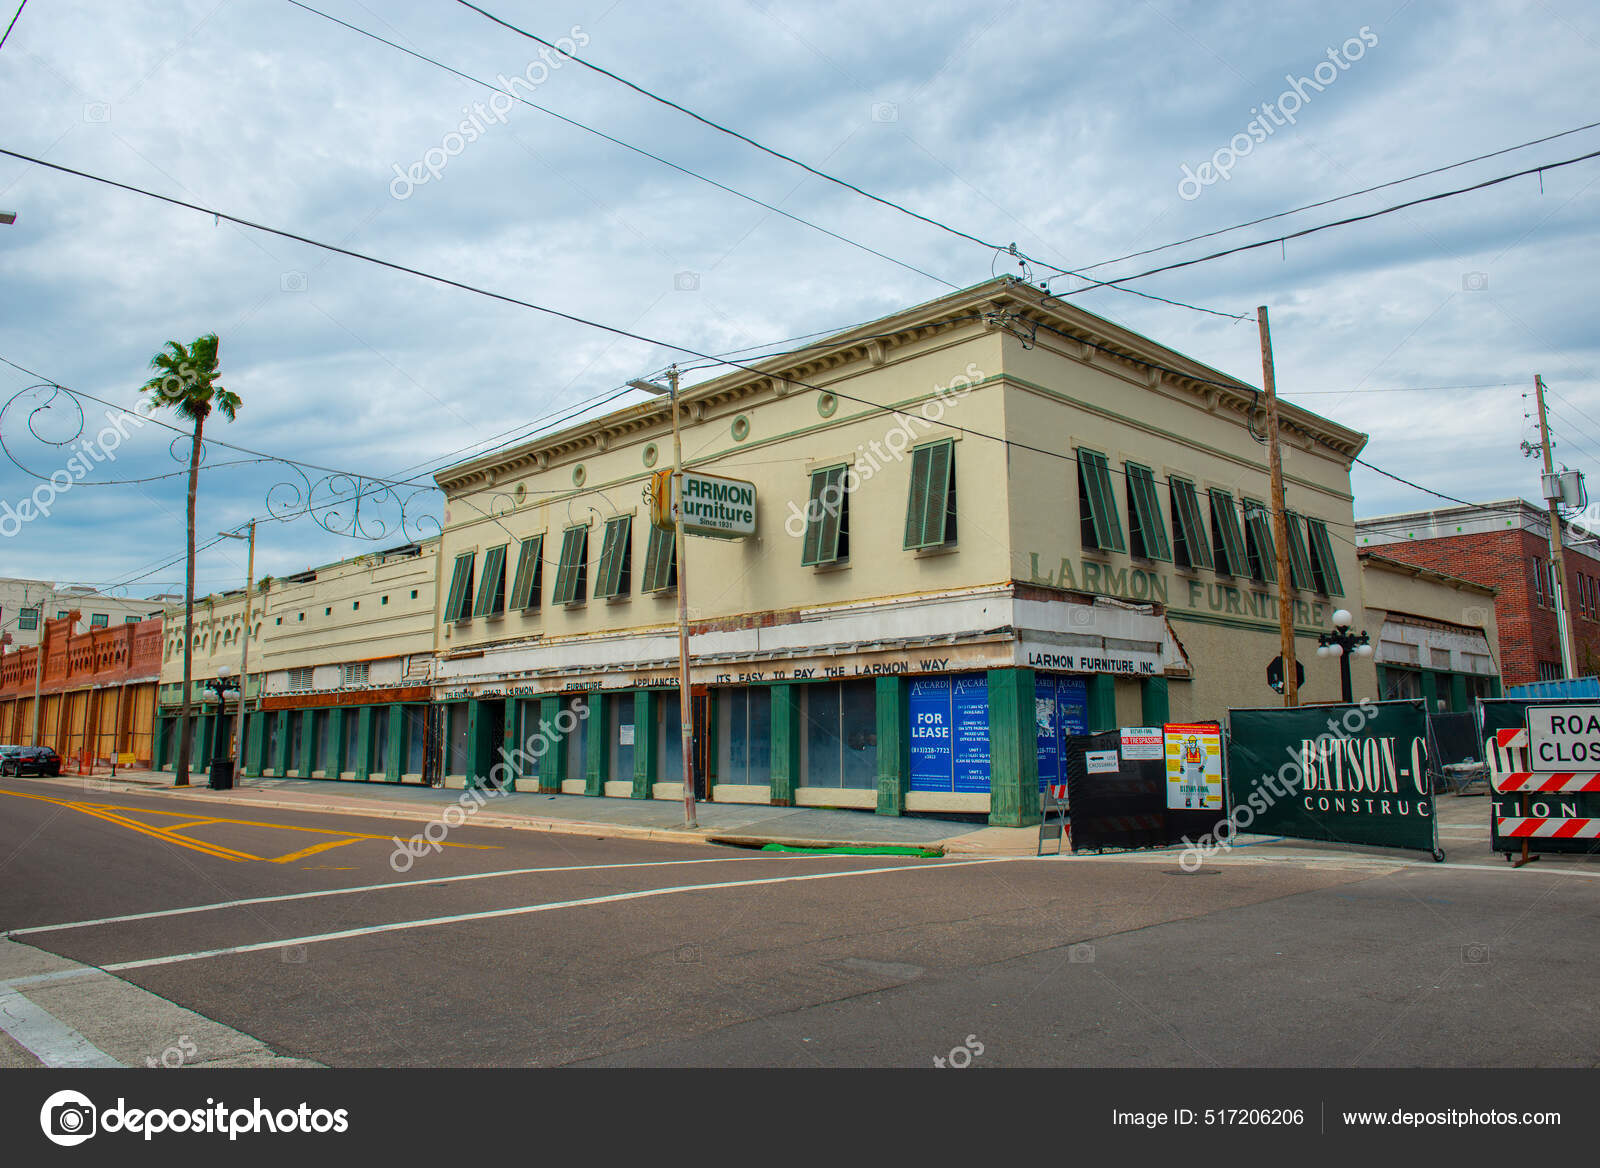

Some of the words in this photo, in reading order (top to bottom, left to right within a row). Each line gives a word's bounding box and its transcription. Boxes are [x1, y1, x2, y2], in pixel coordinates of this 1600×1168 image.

[682, 479, 752, 506] ARMON
[683, 500, 753, 524] urniture
[700, 518, 717, 527] Since
[1029, 552, 1168, 603] LARMON
[739, 672, 764, 683] EASY
[774, 671, 785, 680] TO
[794, 668, 815, 679] PAY
[824, 666, 845, 677] THE
[855, 661, 908, 676] LARMON
[920, 658, 949, 671] WAY
[1029, 652, 1073, 668] LARMON
[1080, 656, 1134, 673] FURNITURE
[1139, 661, 1156, 673] INC.
[566, 681, 602, 691] FURNITURE
[633, 677, 680, 687] APPLIANCES
[912, 680, 948, 696] ACCARDI
[918, 713, 942, 724] FOR
[912, 727, 949, 738] LEASE
[1037, 727, 1055, 738] ASE
[1302, 736, 1429, 795] BATSON-C
[1304, 797, 1430, 817] CONSTRUC
